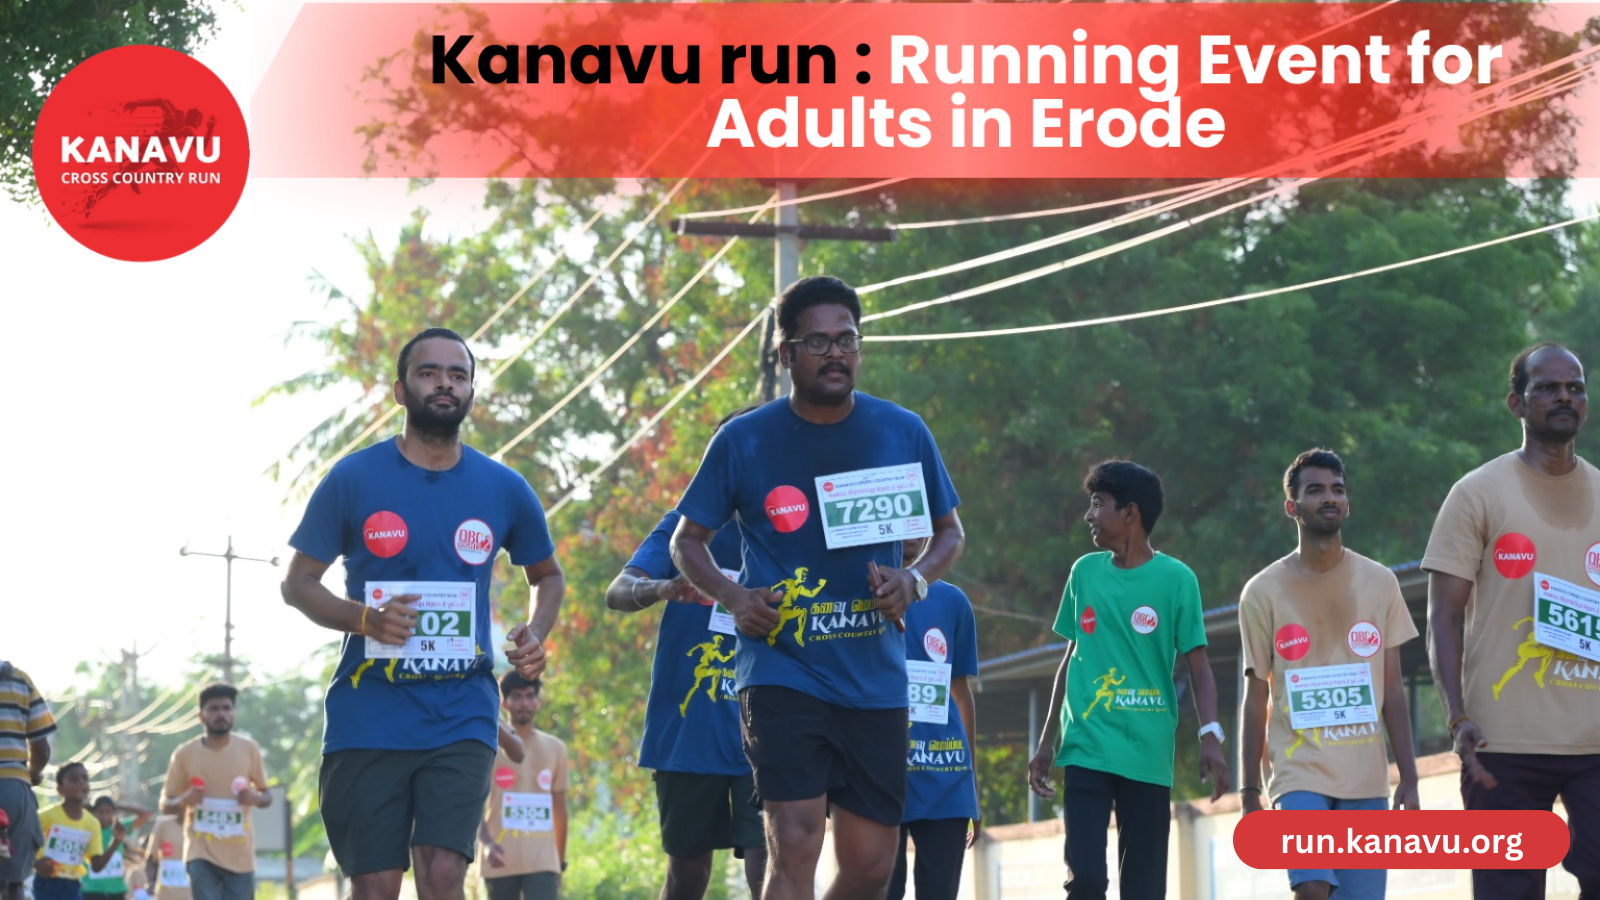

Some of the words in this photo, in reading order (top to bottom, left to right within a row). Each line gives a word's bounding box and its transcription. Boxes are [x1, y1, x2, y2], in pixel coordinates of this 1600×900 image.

[770, 503, 806, 517] KANAVU
[836, 494, 913, 524] 7290
[368, 529, 405, 540] KANAVU
[878, 524, 894, 535] 5K
[1498, 552, 1534, 561] KANAVU
[413, 611, 460, 636] 02
[420, 640, 435, 651] 5K
[1280, 636, 1308, 650] KANAVU
[1579, 639, 1591, 651] 5K
[1553, 661, 1600, 681] KAN
[908, 684, 937, 704] 89
[1115, 695, 1165, 706] KANAVU
[1301, 686, 1363, 710] 5305
[1334, 710, 1346, 719] 5K
